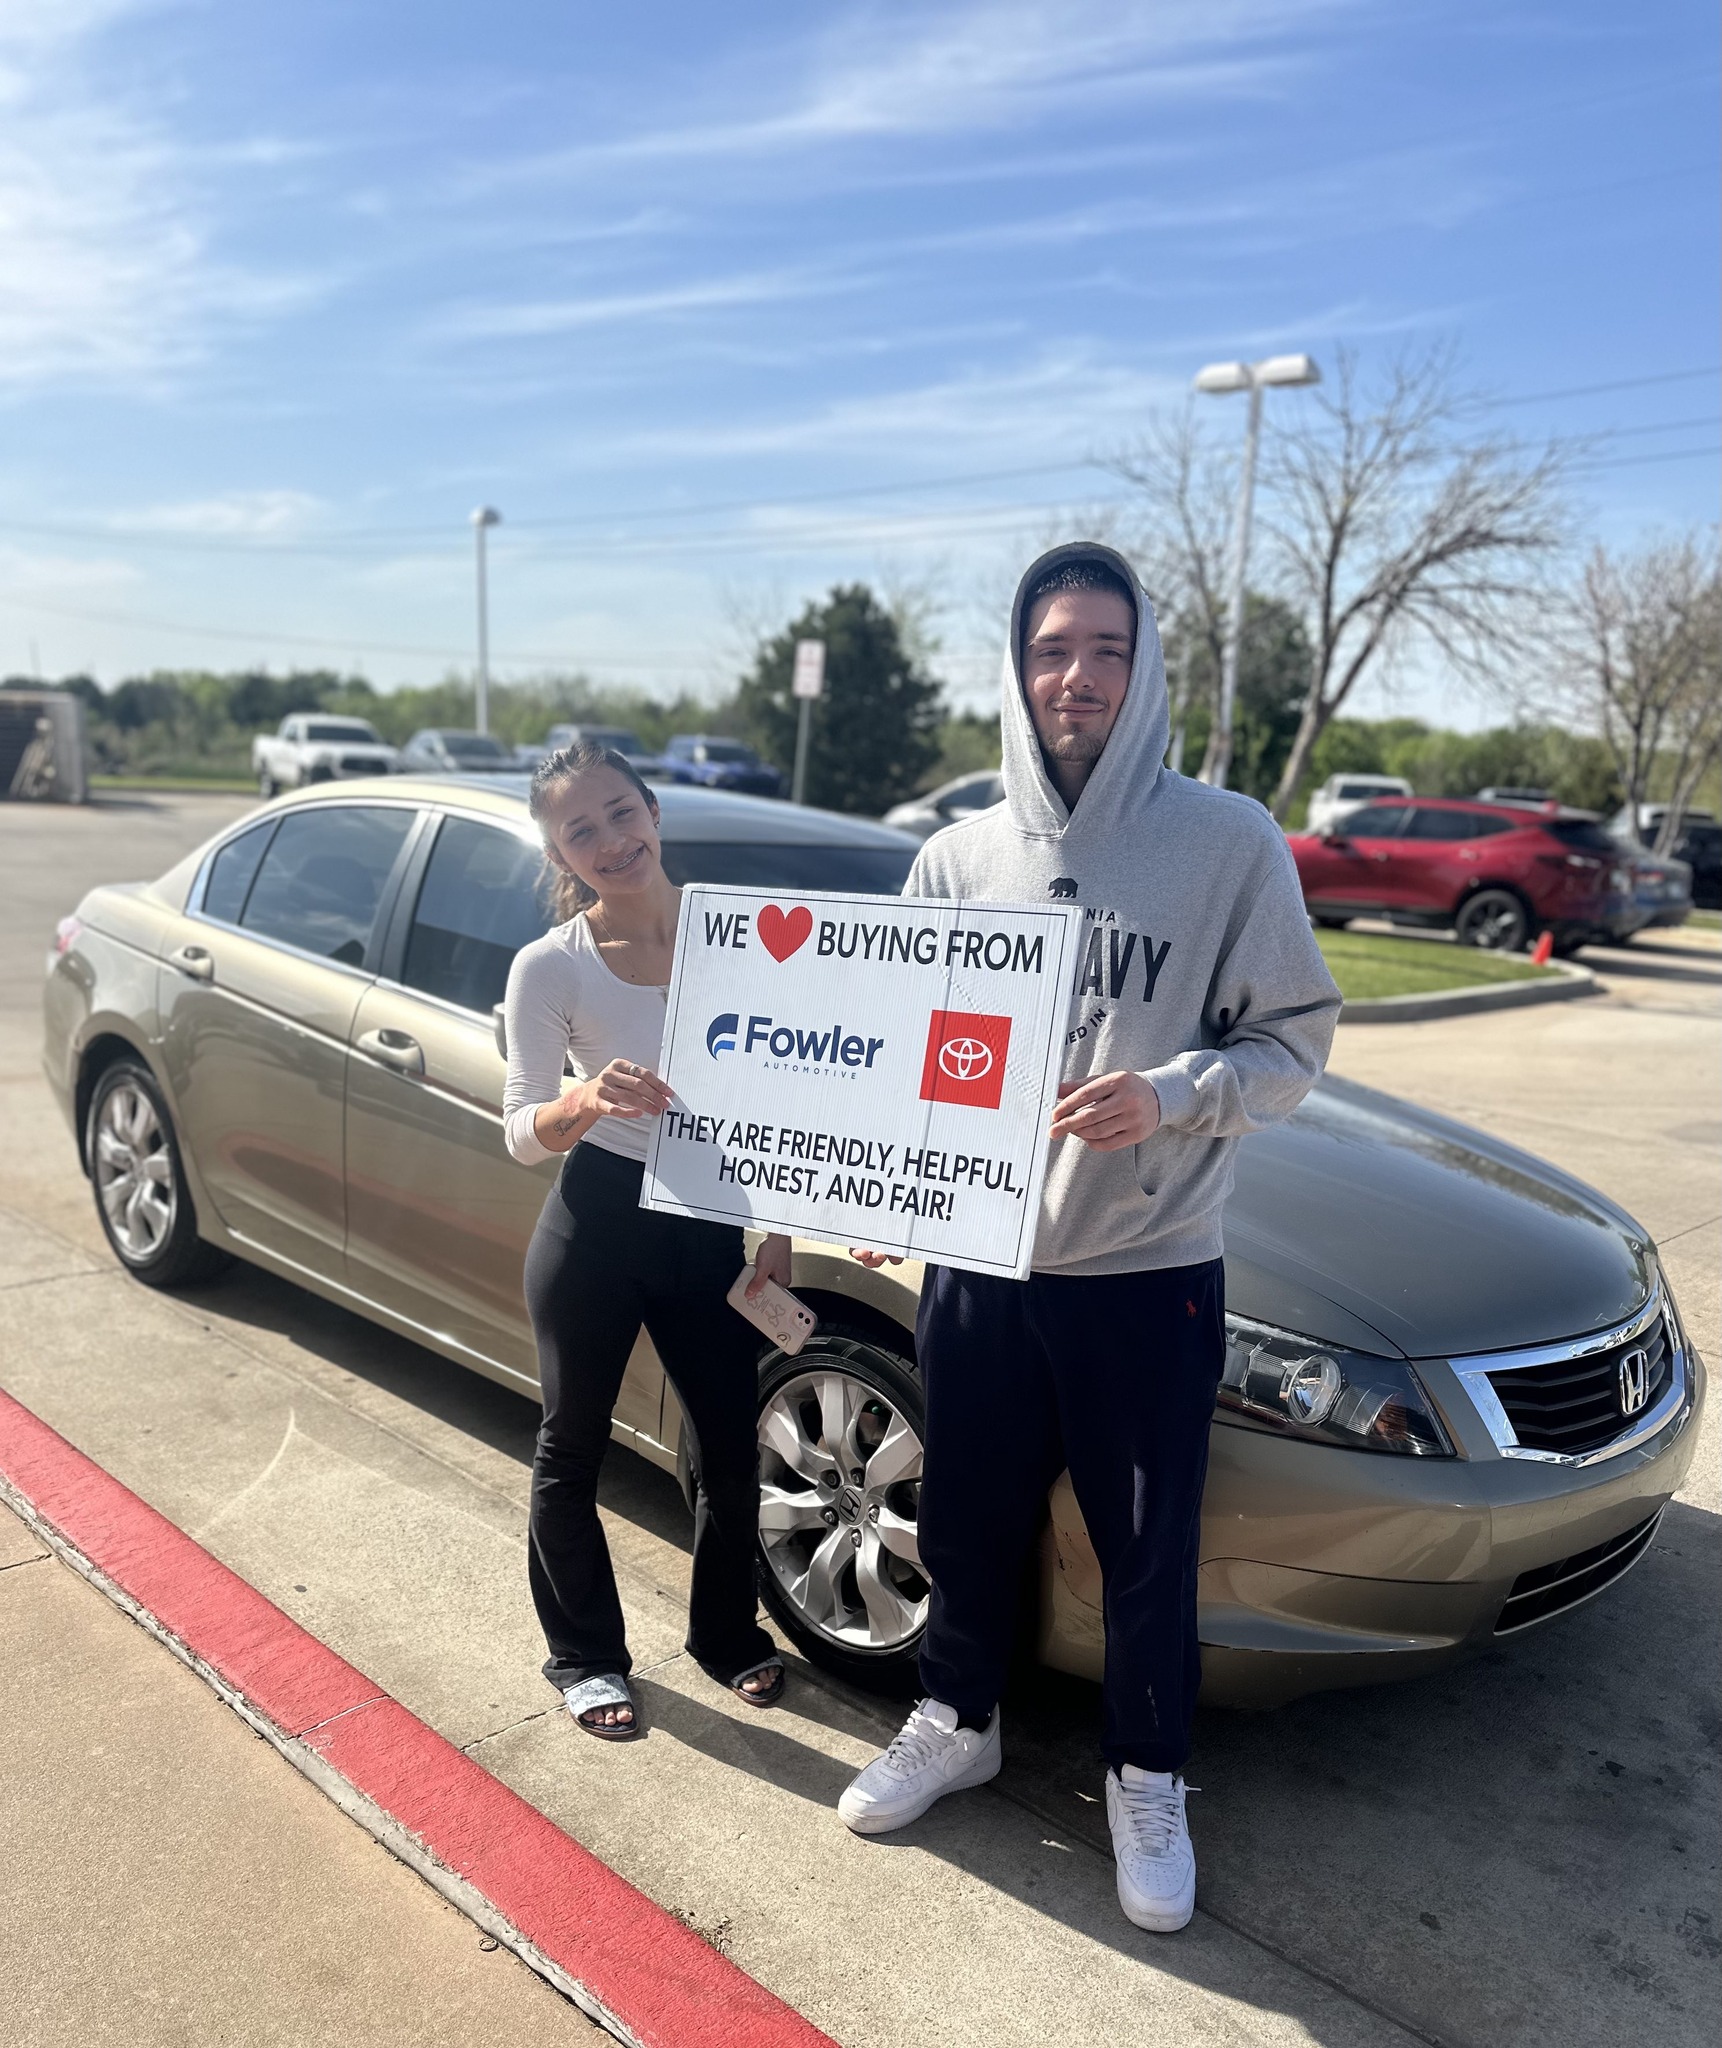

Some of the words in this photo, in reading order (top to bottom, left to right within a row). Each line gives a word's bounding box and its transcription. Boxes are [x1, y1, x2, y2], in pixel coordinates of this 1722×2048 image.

[704, 911, 750, 949] WE
[817, 920, 938, 965] BUYING
[945, 929, 1044, 974] FROM
[1072, 926, 1172, 1003] AVY
[744, 1015, 885, 1068] Fowler
[1090, 1008, 1107, 1027] IN
[763, 1061, 857, 1079] AUTOMOTIVE
[666, 1110, 725, 1144] THEY
[726, 1120, 774, 1153] ARE
[777, 1127, 895, 1178] FRIENDLY,
[903, 1146, 1024, 1199] HELPFUL,
[718, 1155, 819, 1203] HONEST,
[825, 1175, 884, 1208] AND
[888, 1183, 955, 1222] FAIR!
